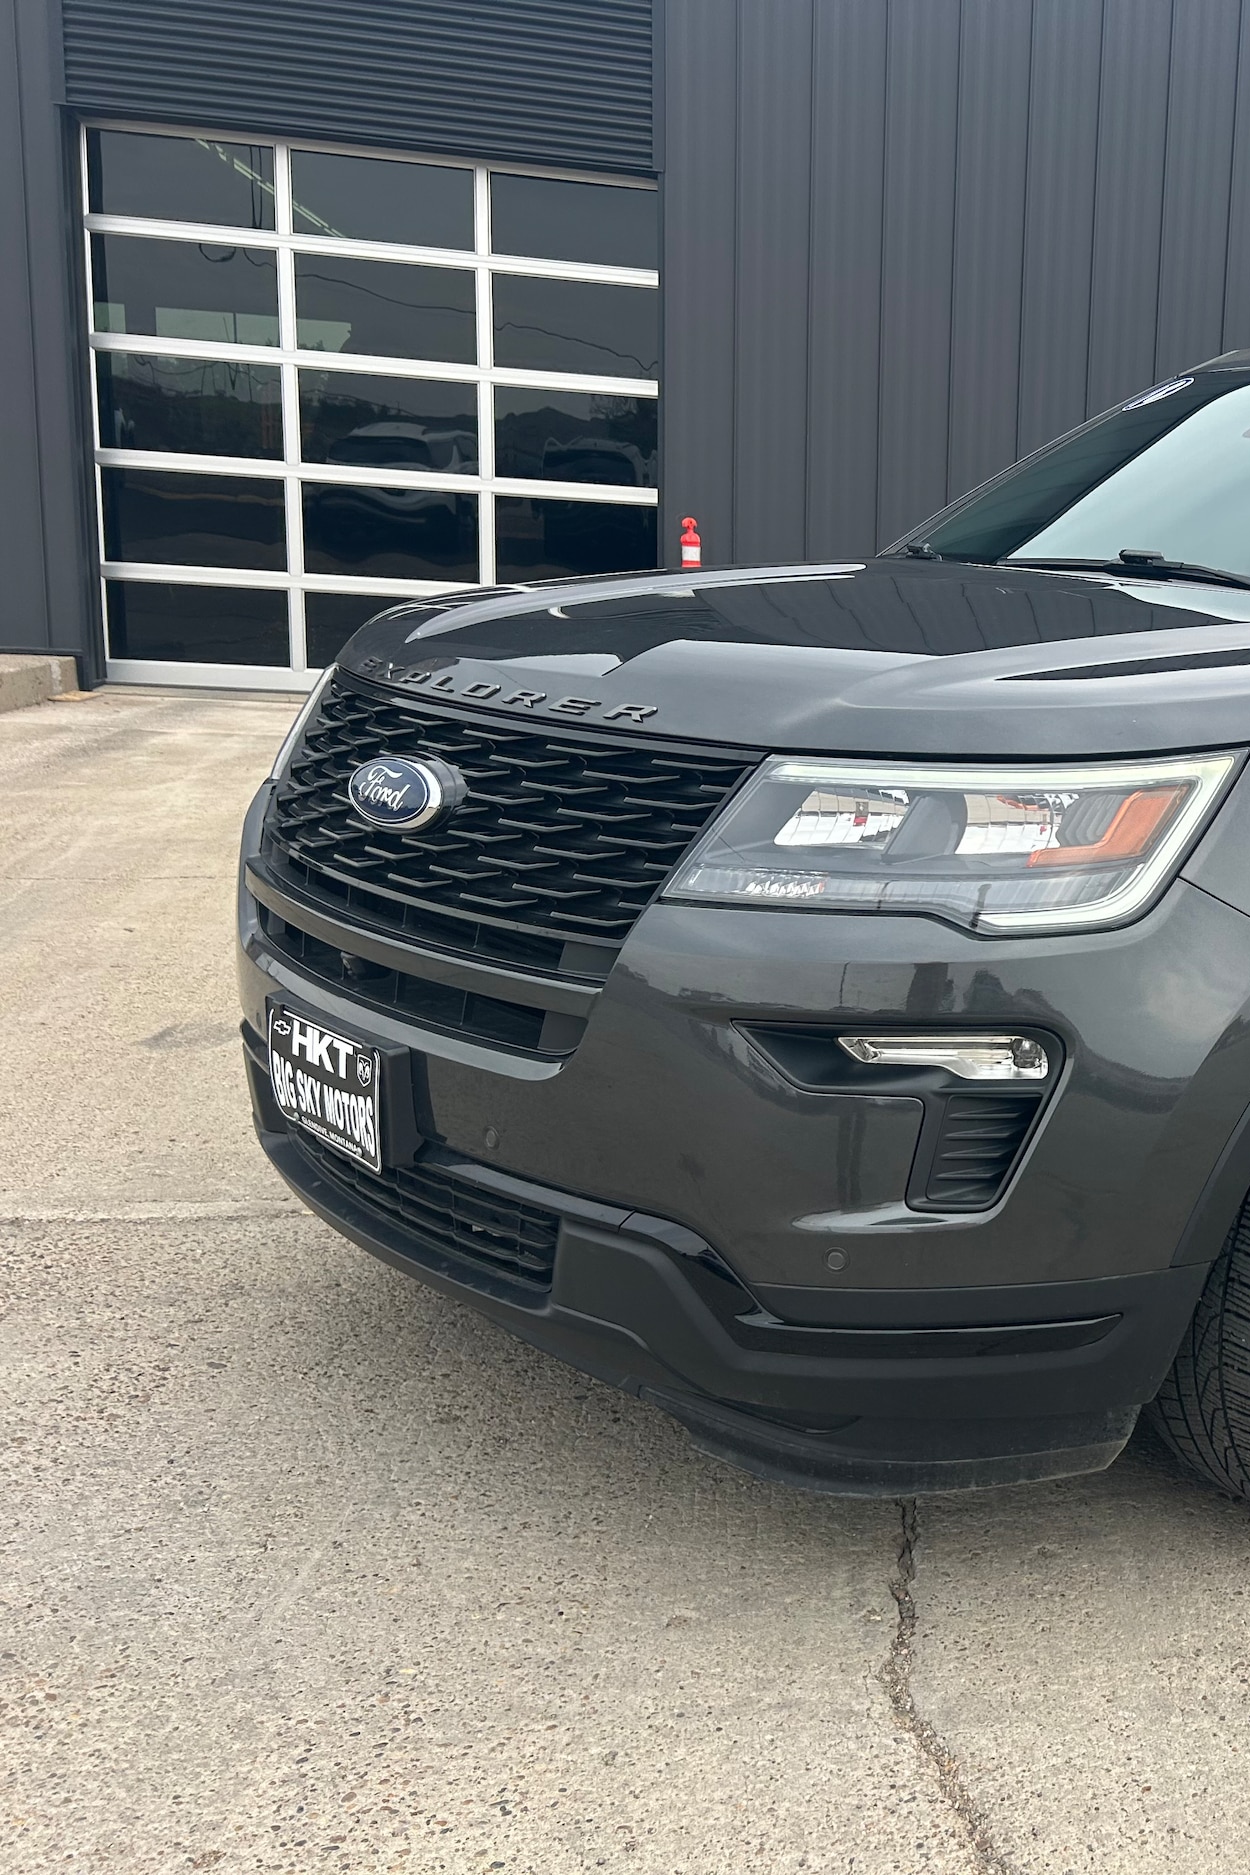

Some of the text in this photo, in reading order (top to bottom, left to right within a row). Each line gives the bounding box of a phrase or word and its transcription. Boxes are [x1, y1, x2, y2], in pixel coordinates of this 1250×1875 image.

[360, 656, 658, 723] EXPLORER
[358, 765, 411, 811] Ford
[291, 1019, 354, 1079] HKT
[272, 1050, 376, 1158] BIG SKY MOTORS
